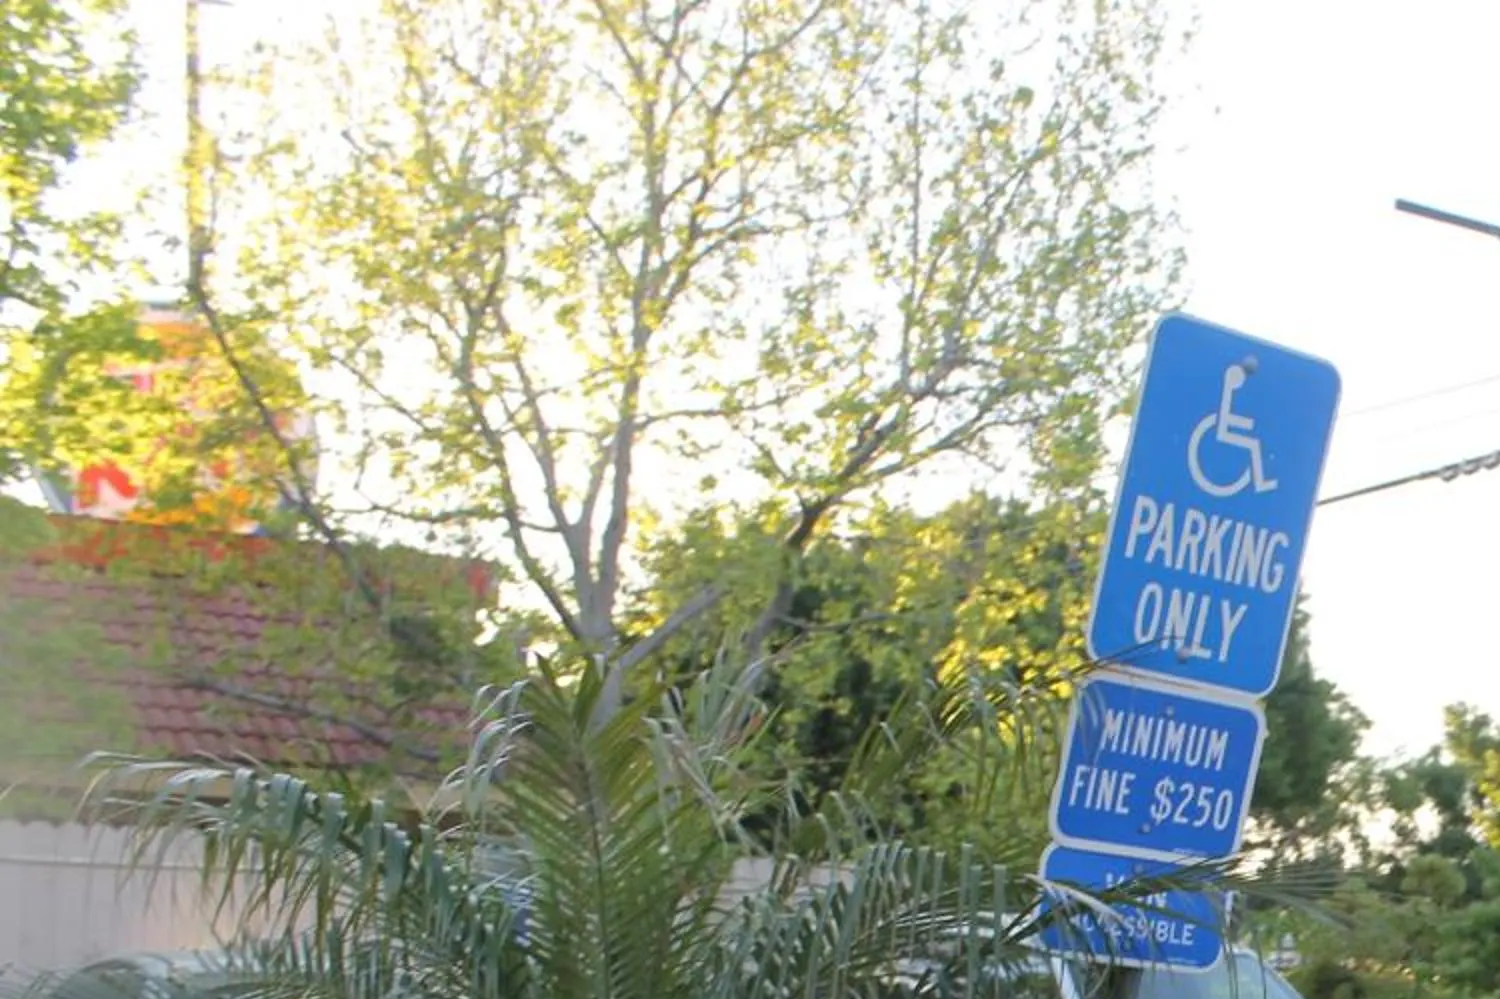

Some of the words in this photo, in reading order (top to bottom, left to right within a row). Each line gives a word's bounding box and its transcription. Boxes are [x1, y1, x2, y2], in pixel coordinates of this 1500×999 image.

[1124, 495, 1289, 593] PARKING
[1134, 582, 1248, 662] ONLY
[1101, 708, 1229, 772] MINIMUM
[1068, 764, 1136, 815] FINE
[1150, 775, 1234, 832] $250
[1069, 910, 1197, 945] CESSBLE
